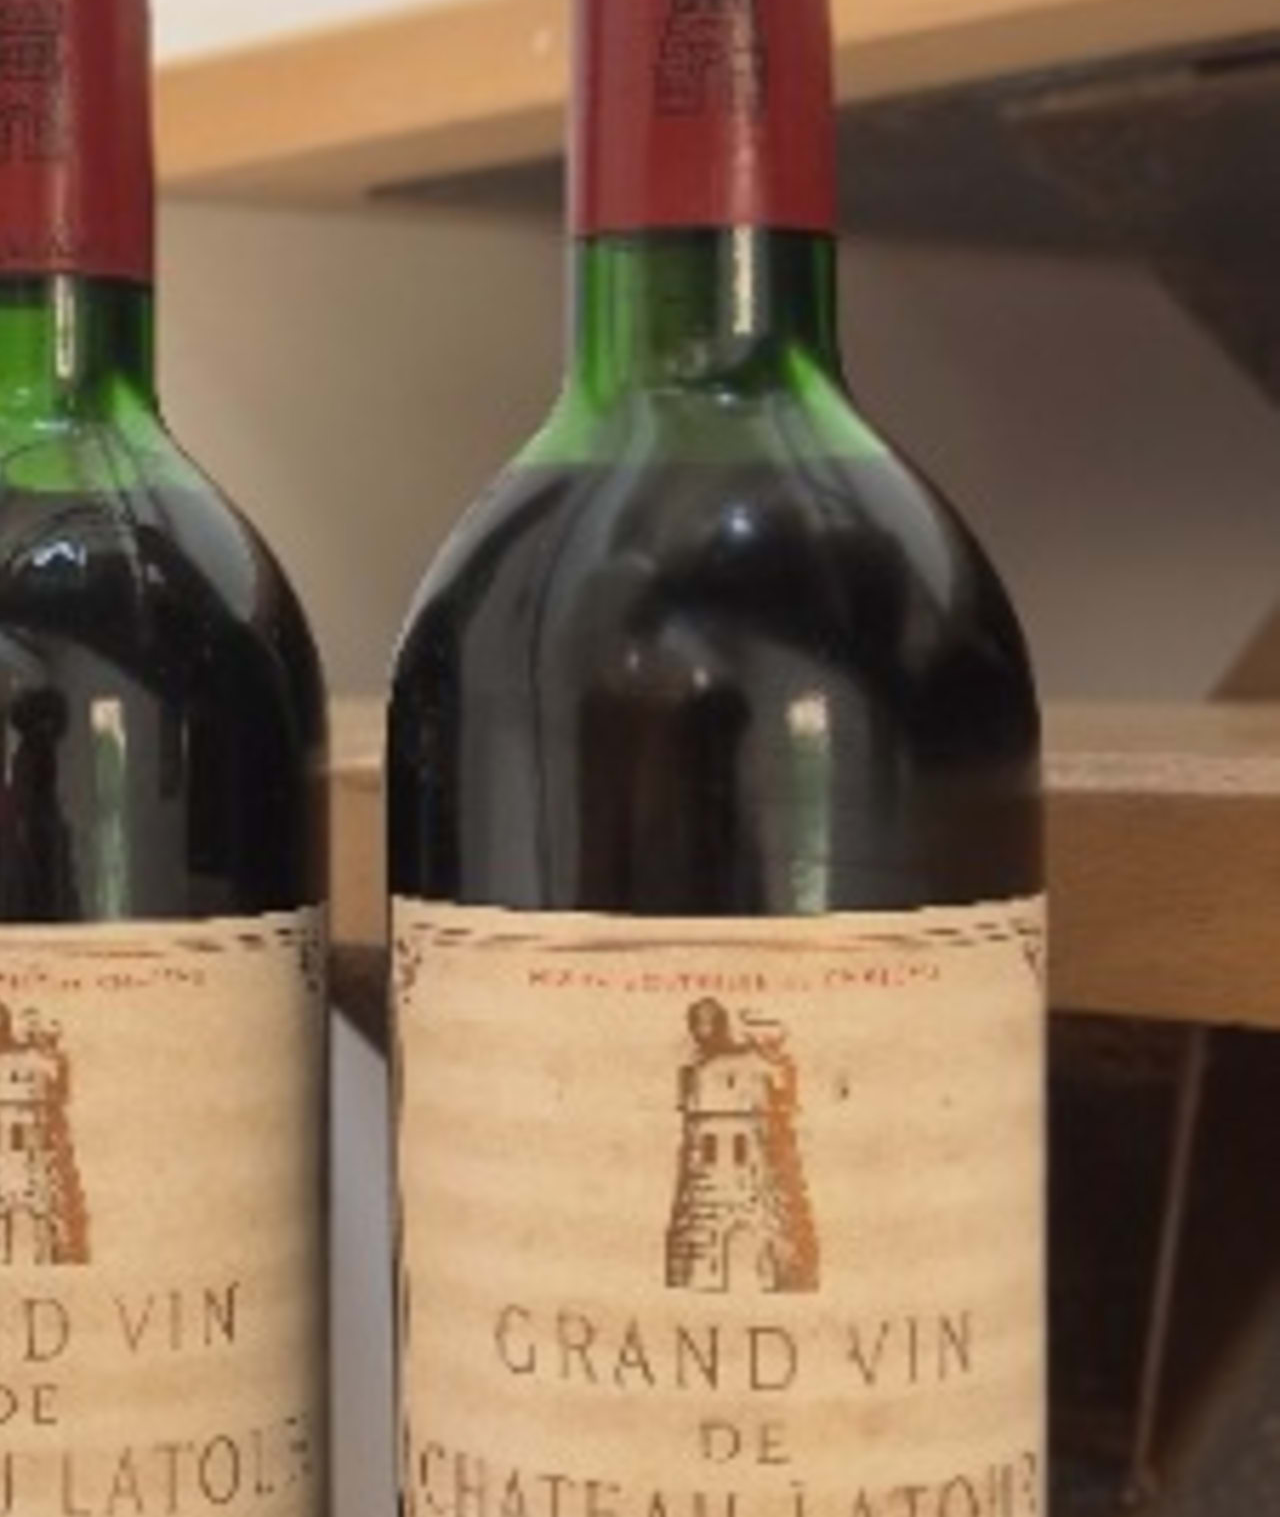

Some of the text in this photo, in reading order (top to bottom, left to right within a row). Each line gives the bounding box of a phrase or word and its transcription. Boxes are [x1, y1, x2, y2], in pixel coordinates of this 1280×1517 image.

[115, 1282, 241, 1352] VIN
[495, 1304, 972, 1391] GRAND VIN
[701, 1420, 791, 1465] DE
